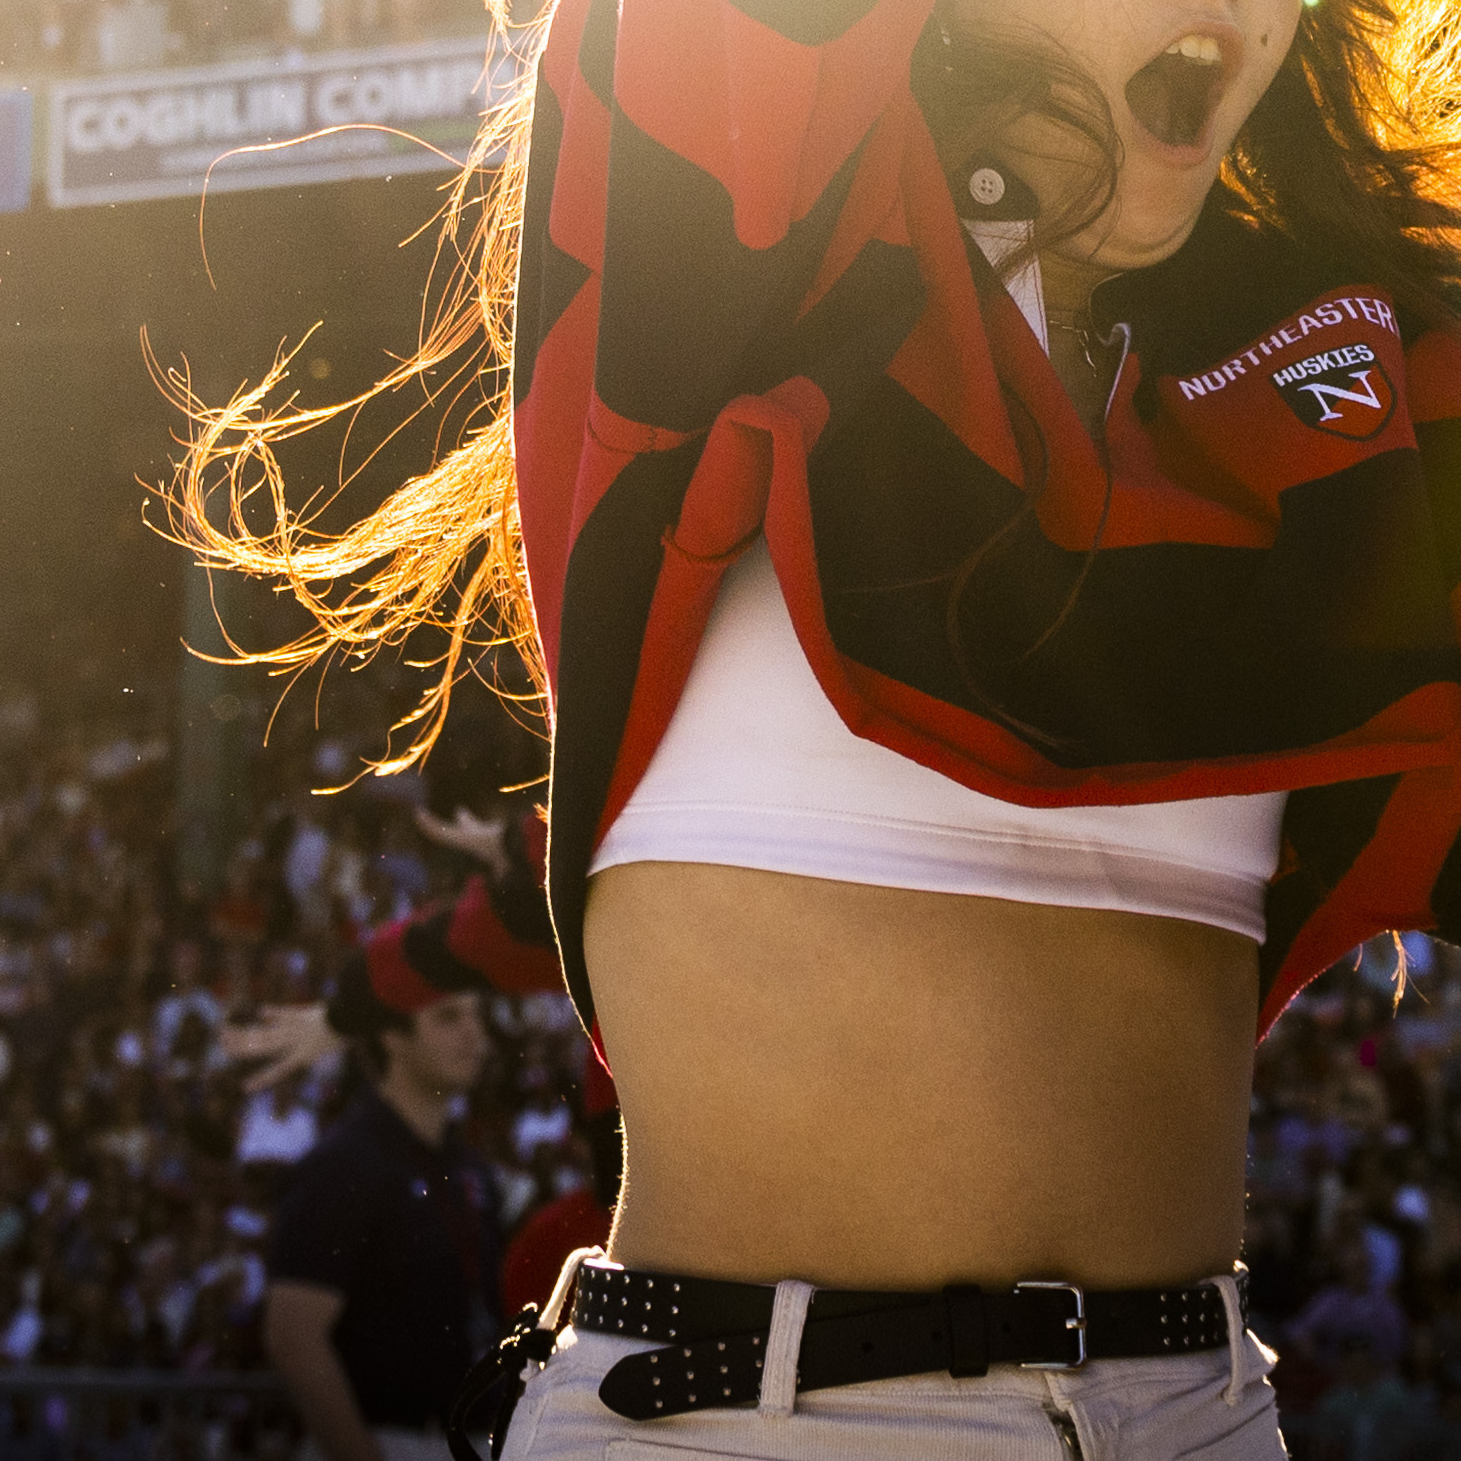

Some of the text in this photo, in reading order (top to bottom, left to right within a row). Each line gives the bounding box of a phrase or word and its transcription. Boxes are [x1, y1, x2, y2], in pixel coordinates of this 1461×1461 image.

[67, 81, 308, 152] COGHLIN
[1273, 344, 1375, 387] HUSKIES
[1297, 370, 1382, 421] N
